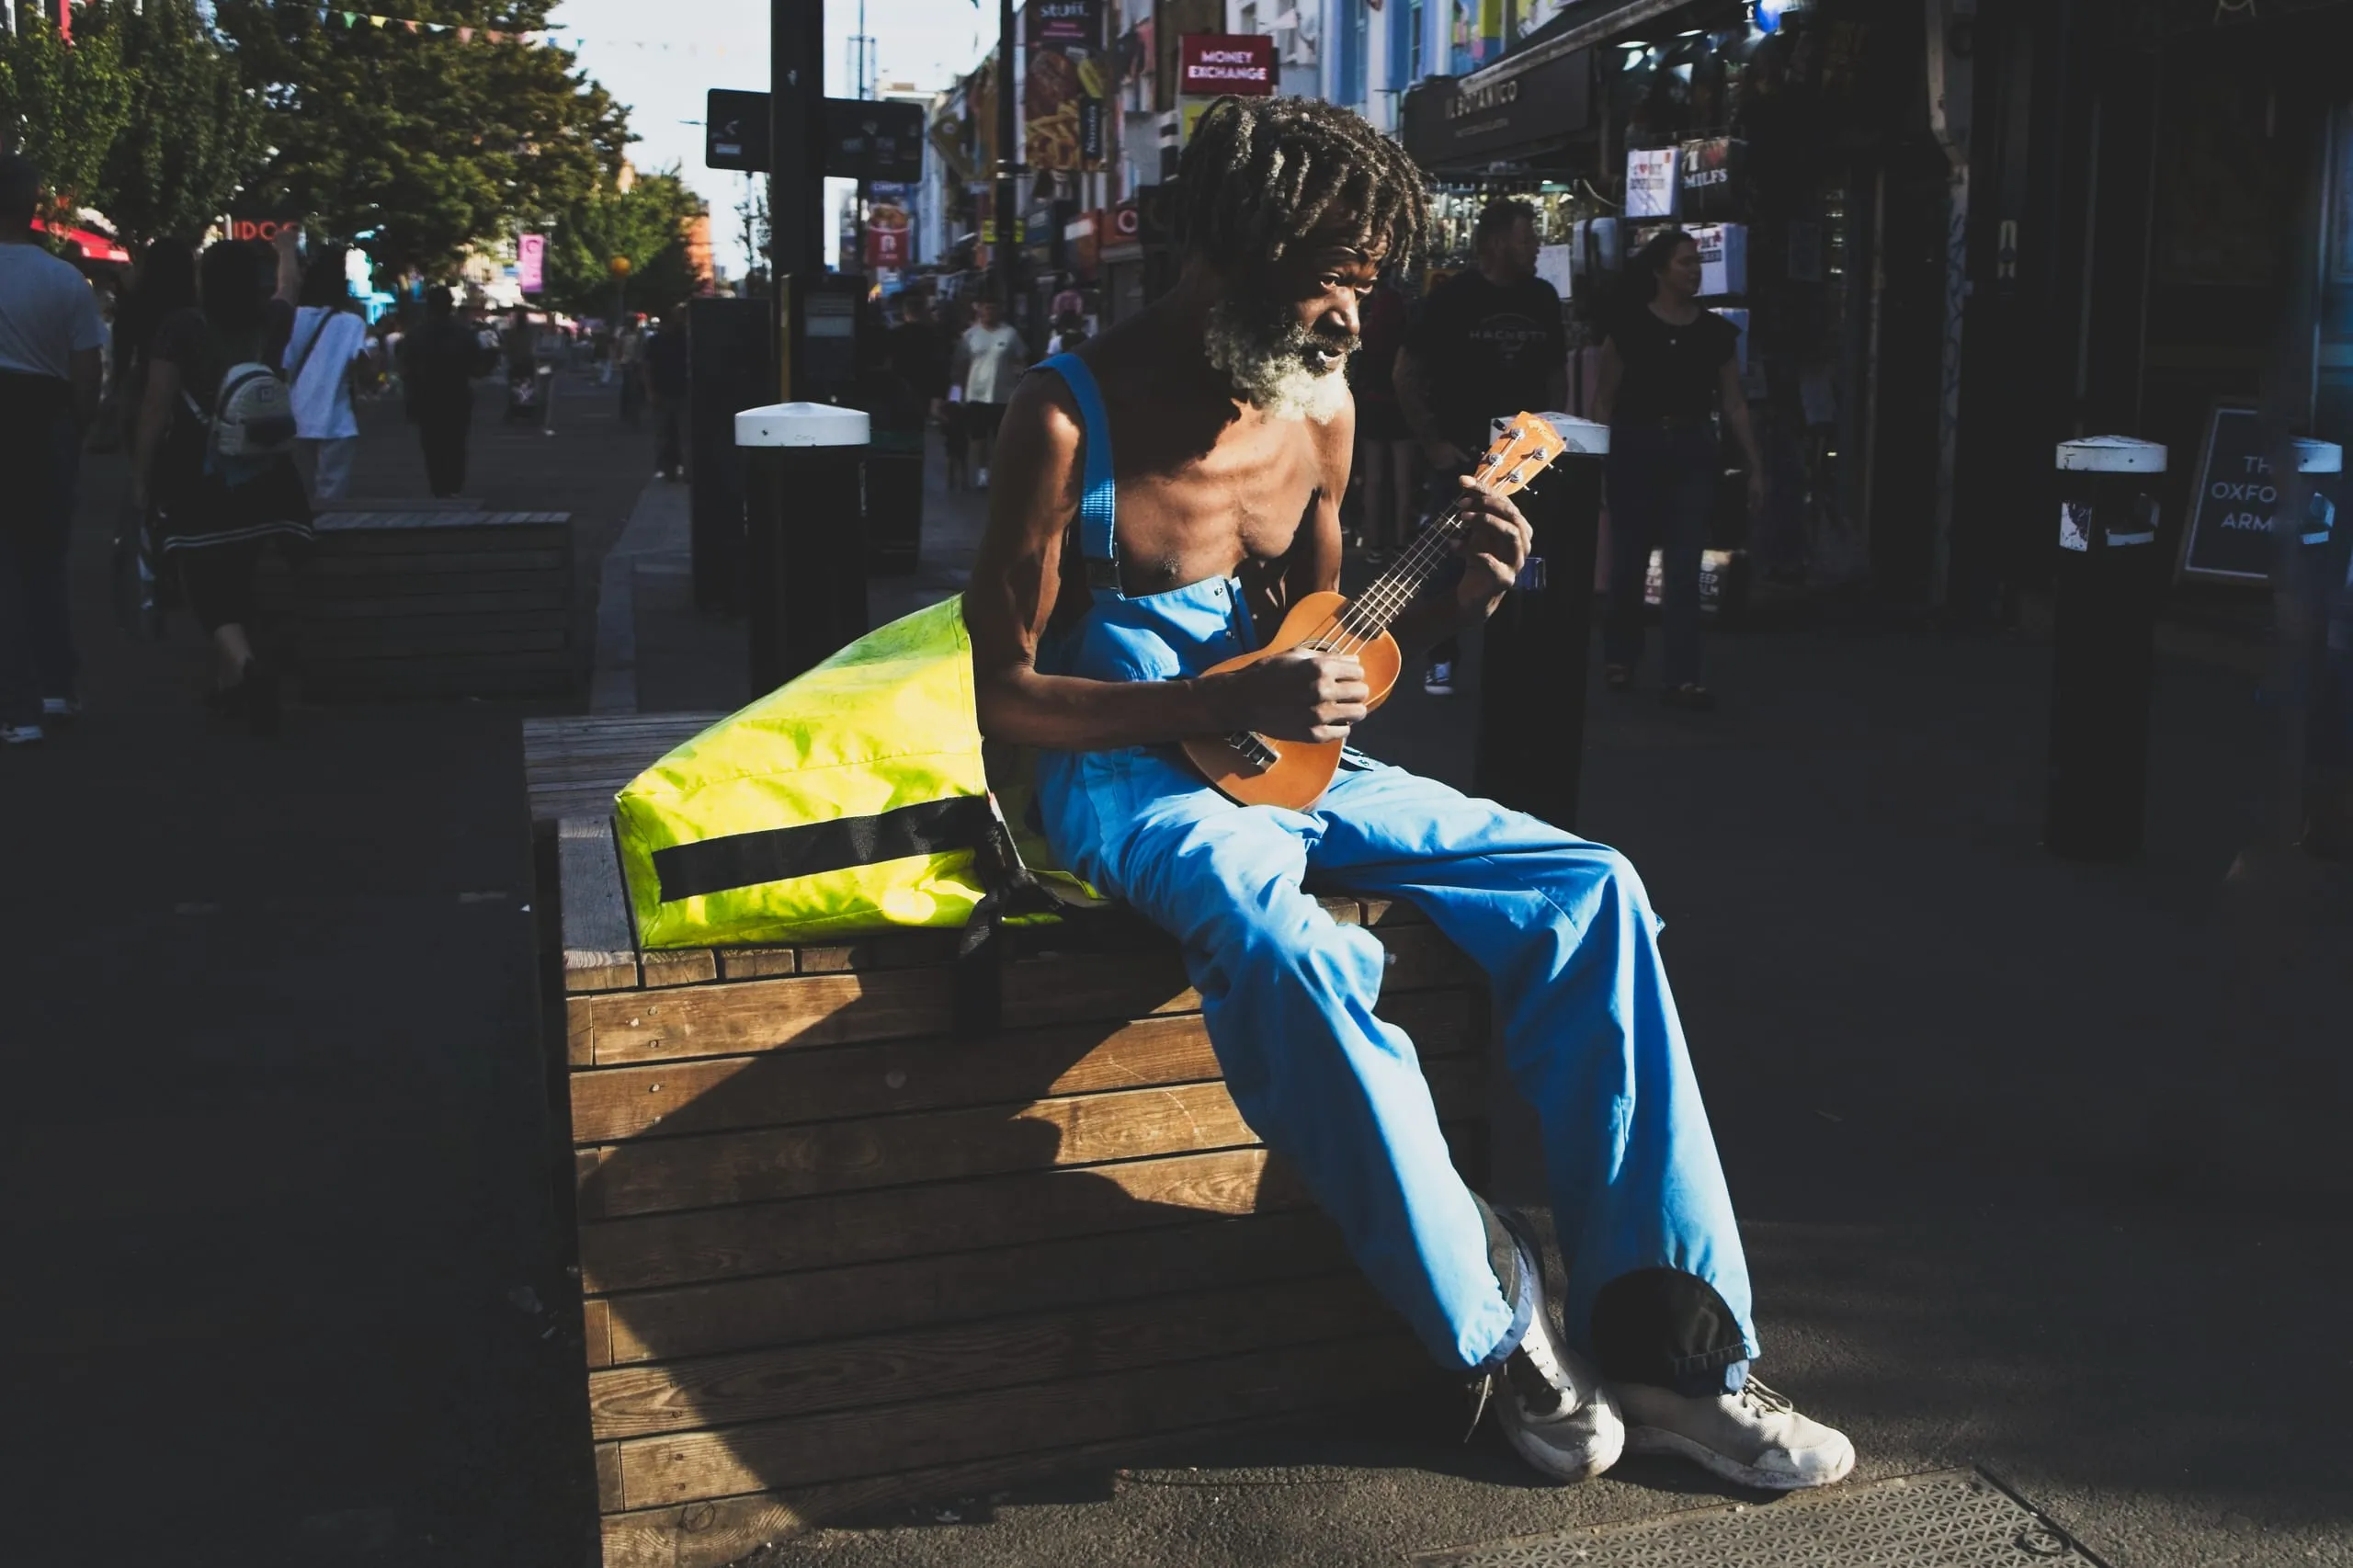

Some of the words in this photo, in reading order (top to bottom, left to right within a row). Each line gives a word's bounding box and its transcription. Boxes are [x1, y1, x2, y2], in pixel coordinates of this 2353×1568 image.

[1200, 51, 1254, 63] MONEY
[1188, 65, 1267, 80] EXCHANGE
[1683, 168, 1728, 189] MILFS
[2242, 455, 2273, 474] TH
[2211, 481, 2278, 504] OXFO
[2220, 511, 2274, 532] ARM
